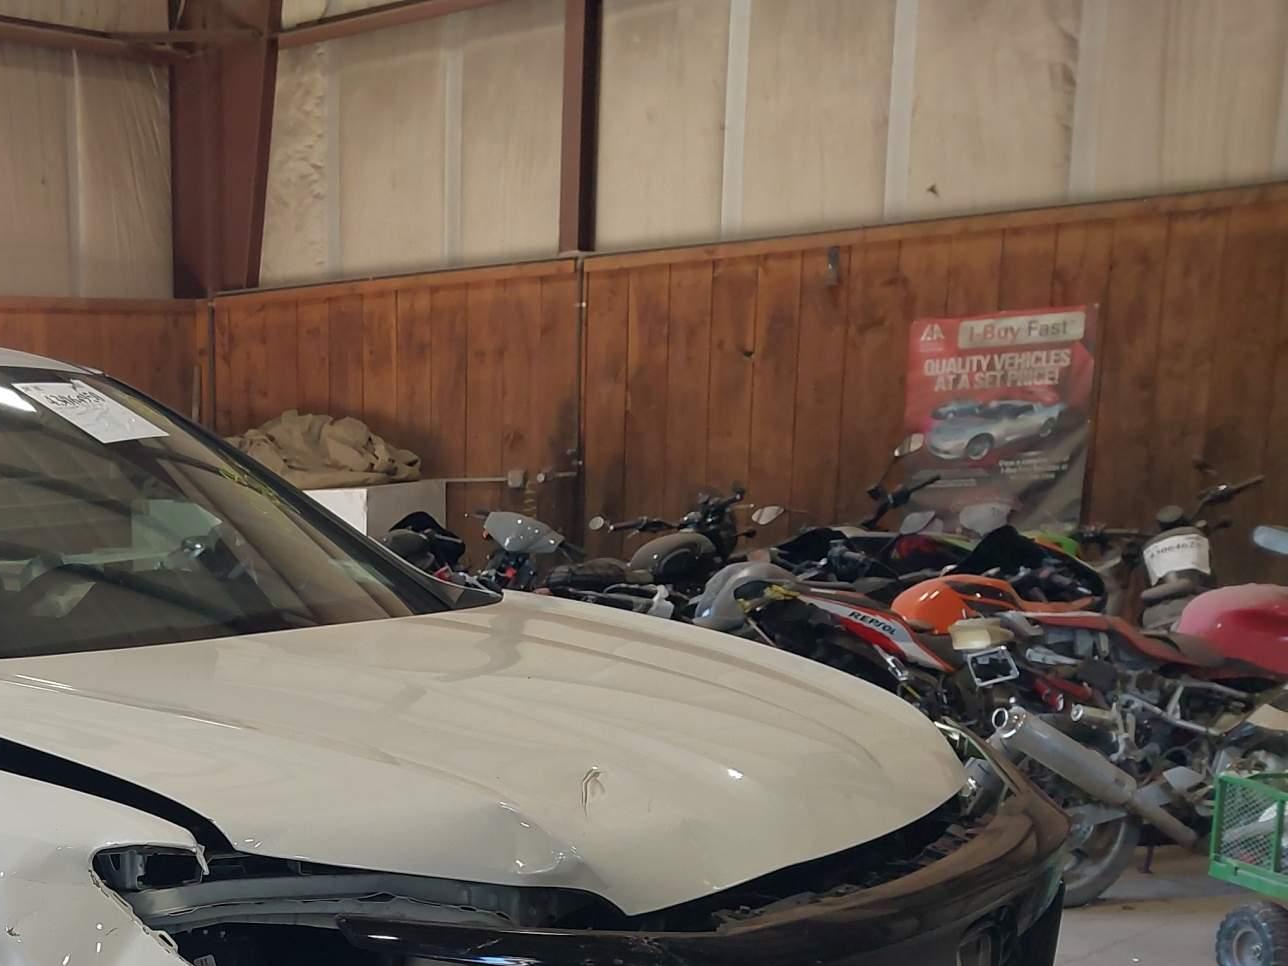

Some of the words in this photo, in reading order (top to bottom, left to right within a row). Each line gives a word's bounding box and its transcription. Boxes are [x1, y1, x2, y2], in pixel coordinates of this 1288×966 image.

[969, 323, 1020, 343] I-Buy
[1027, 319, 1068, 337] Fast
[924, 354, 991, 377] QUALITY
[993, 349, 1072, 371] VEHICLES
[934, 373, 956, 392] AT
[957, 373, 970, 390] A
[974, 371, 1004, 389] SET
[1006, 367, 1060, 388] PRICE!
[848, 611, 897, 635] REPSOL
